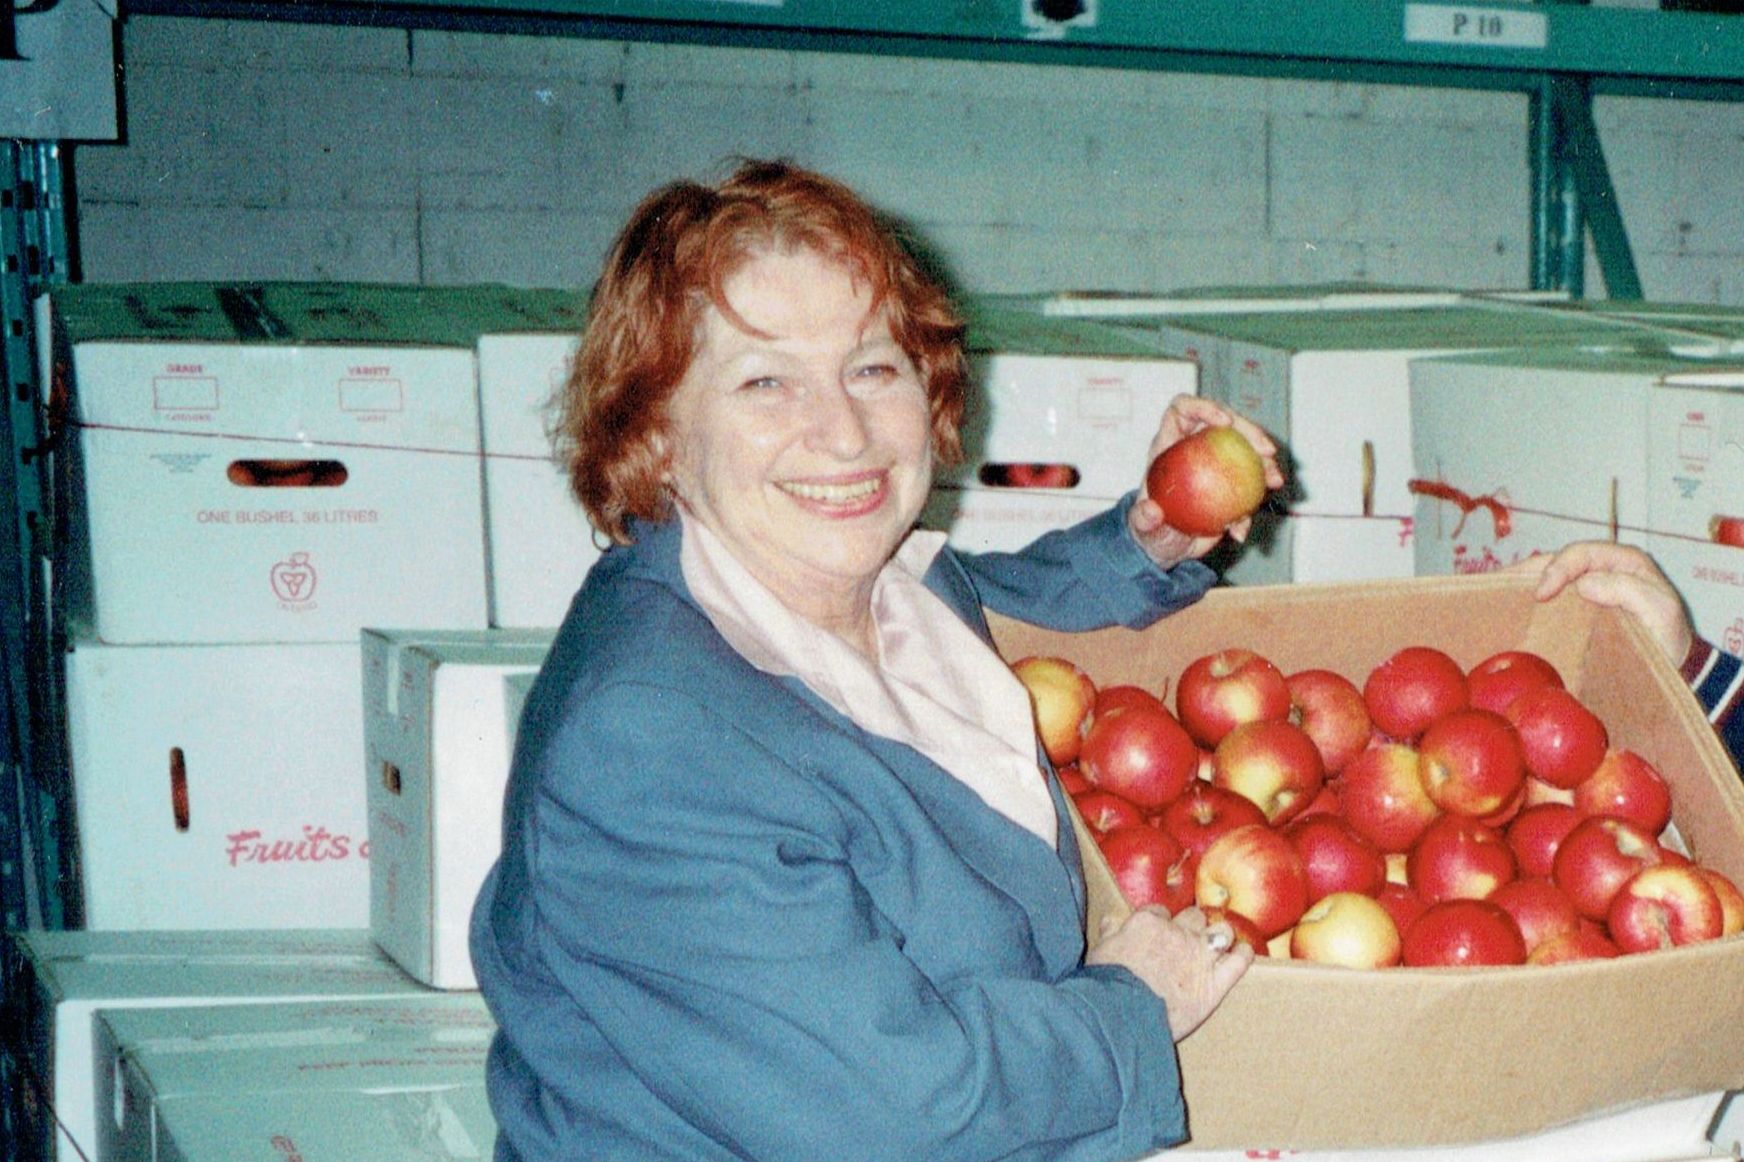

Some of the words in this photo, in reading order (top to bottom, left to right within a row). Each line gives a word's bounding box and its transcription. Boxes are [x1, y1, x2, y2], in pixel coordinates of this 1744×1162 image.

[1453, 13, 1468, 35] P
[197, 511, 230, 524] ONE
[235, 511, 294, 524] BUSHEL
[323, 511, 378, 524] LITRES
[225, 825, 350, 867] Fruits
